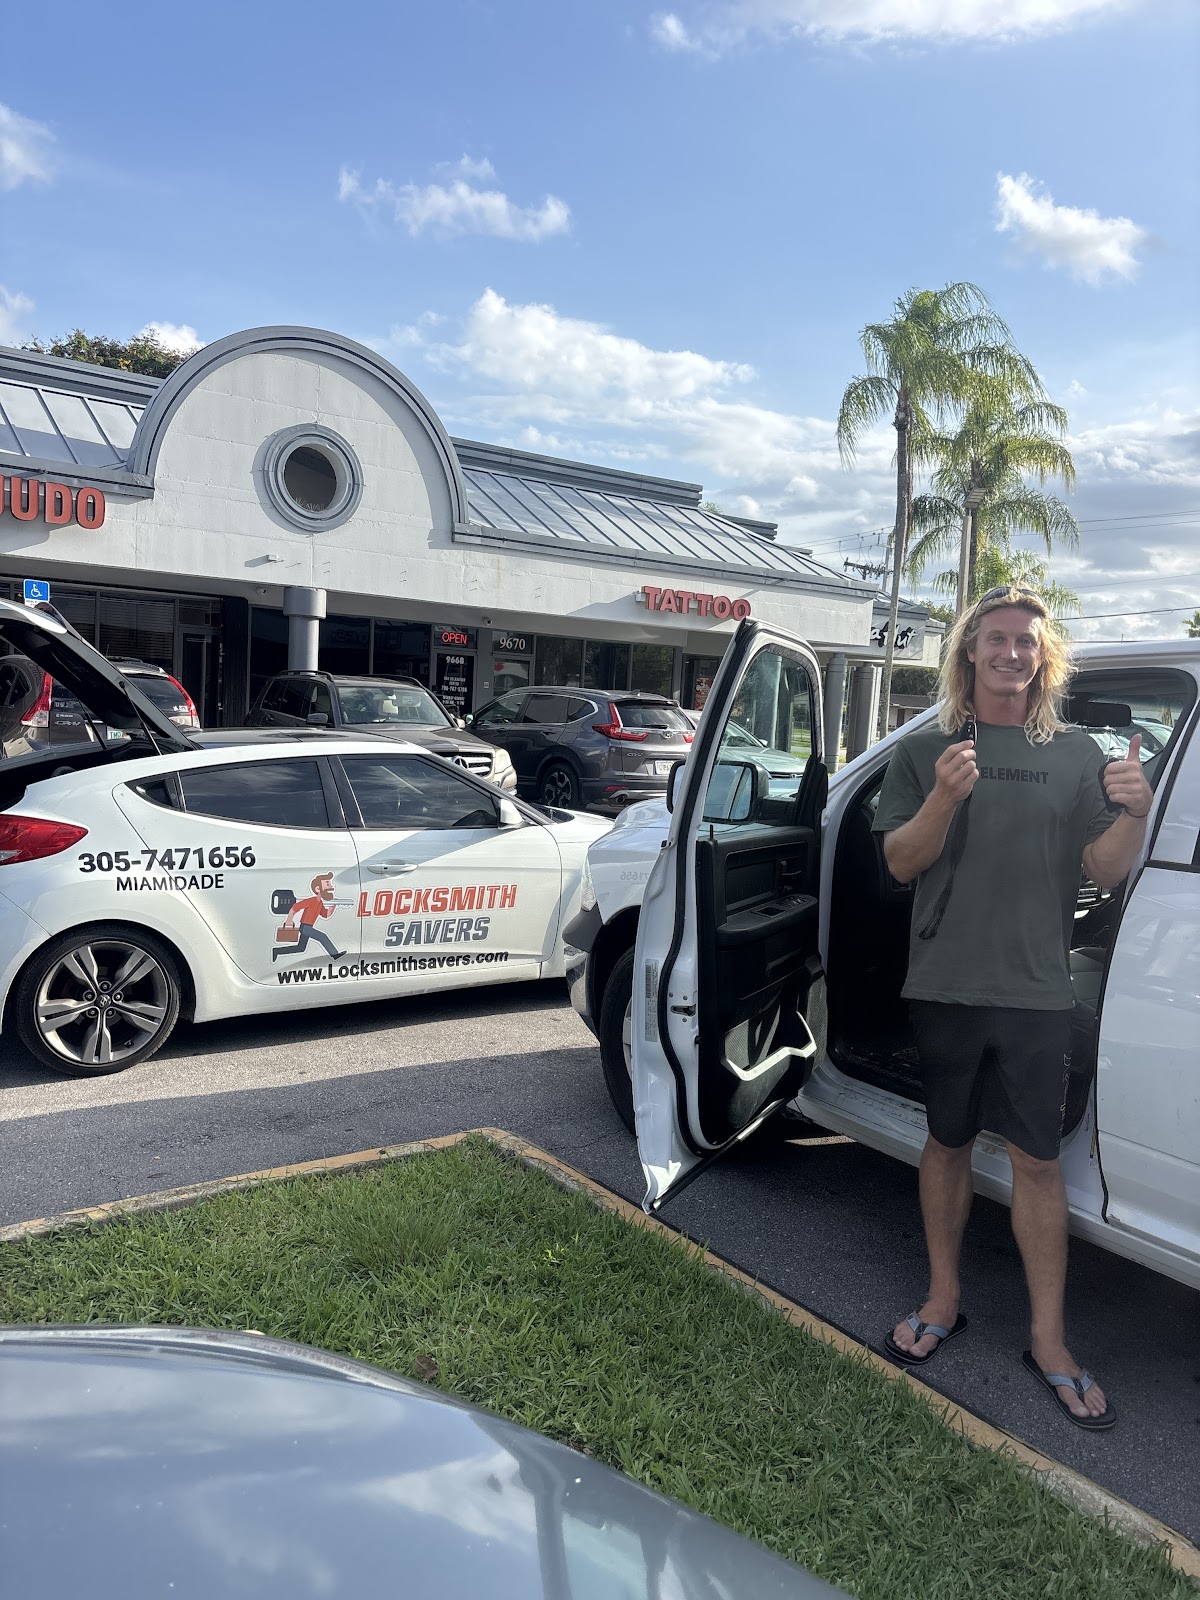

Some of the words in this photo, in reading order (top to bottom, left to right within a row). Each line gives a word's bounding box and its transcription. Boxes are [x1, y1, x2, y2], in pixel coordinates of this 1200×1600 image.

[0, 474, 105, 530] UDO
[641, 586, 752, 621] TATTOO
[441, 631, 468, 645] OPEN
[499, 636, 526, 650] 9670
[445, 655, 465, 665] 9668
[980, 766, 1049, 785] ELEMENT
[78, 845, 257, 874] 305-7471656
[116, 873, 225, 892] MIAMIDADE
[356, 884, 518, 918] LOCKSMITH
[384, 916, 491, 947] SAVERS
[277, 951, 509, 985] www.Locksmithsavers.com
